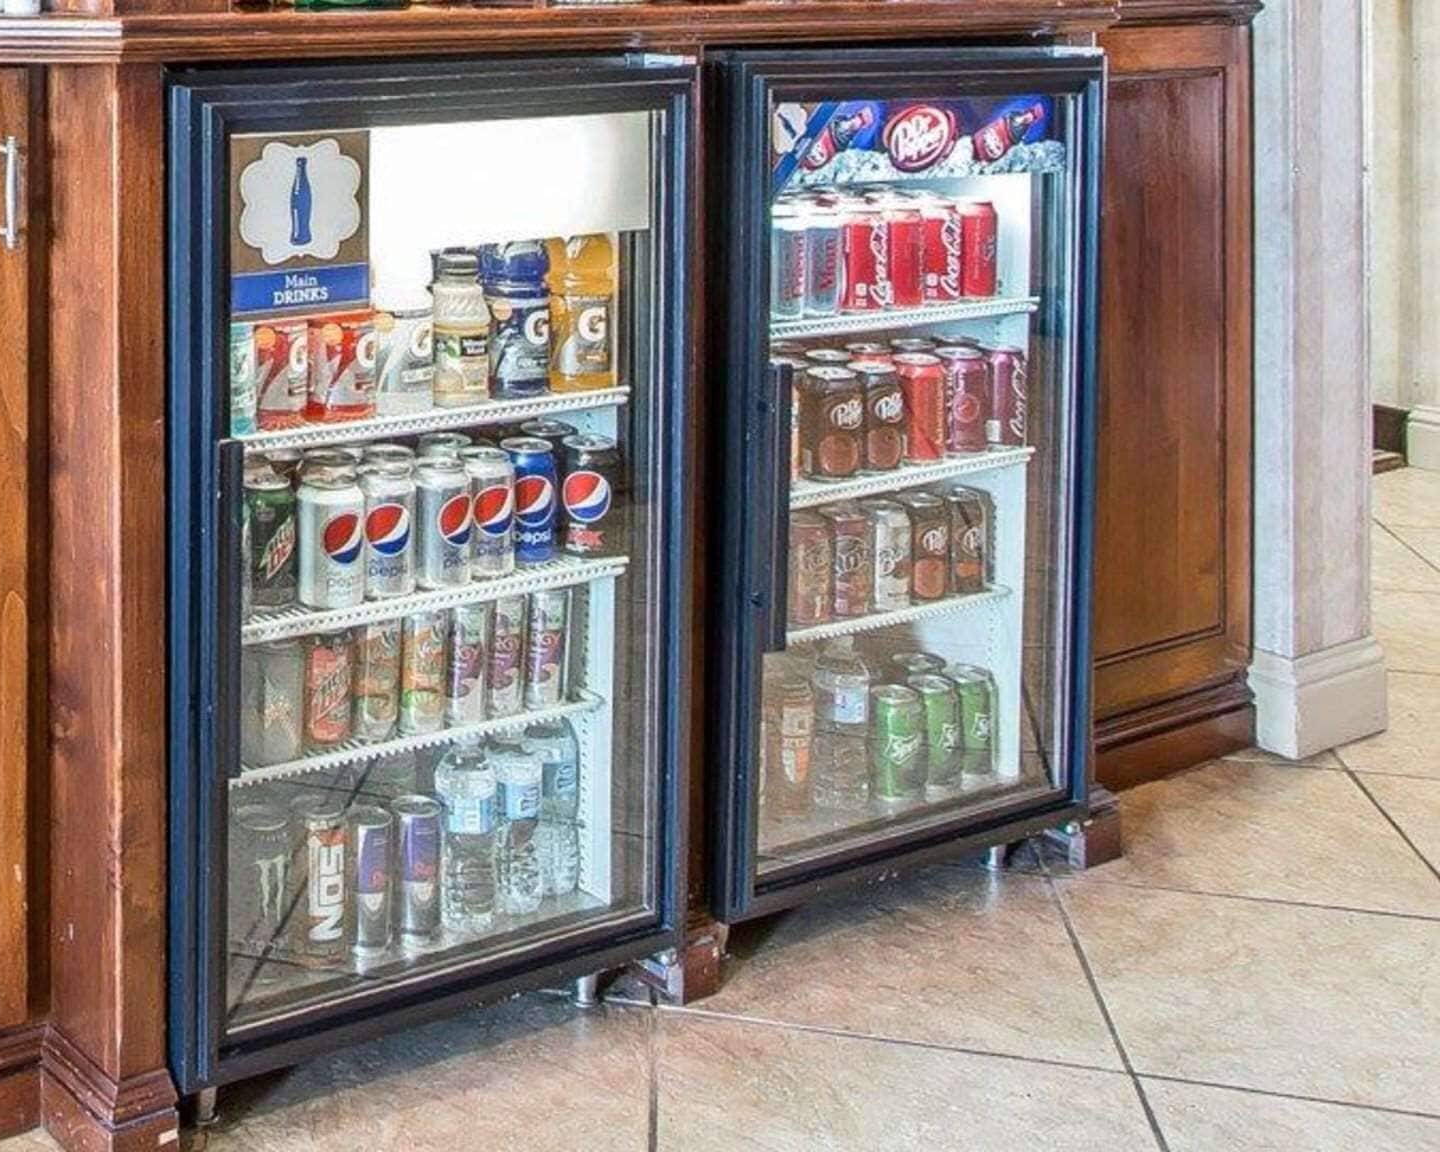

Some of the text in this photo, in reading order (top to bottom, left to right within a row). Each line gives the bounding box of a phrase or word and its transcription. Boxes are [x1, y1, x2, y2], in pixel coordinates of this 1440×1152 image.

[272, 286, 329, 306] DRINKS
[284, 275, 318, 289] Main
[524, 310, 550, 346] G
[577, 306, 607, 342] G
[309, 842, 345, 942] NOS
